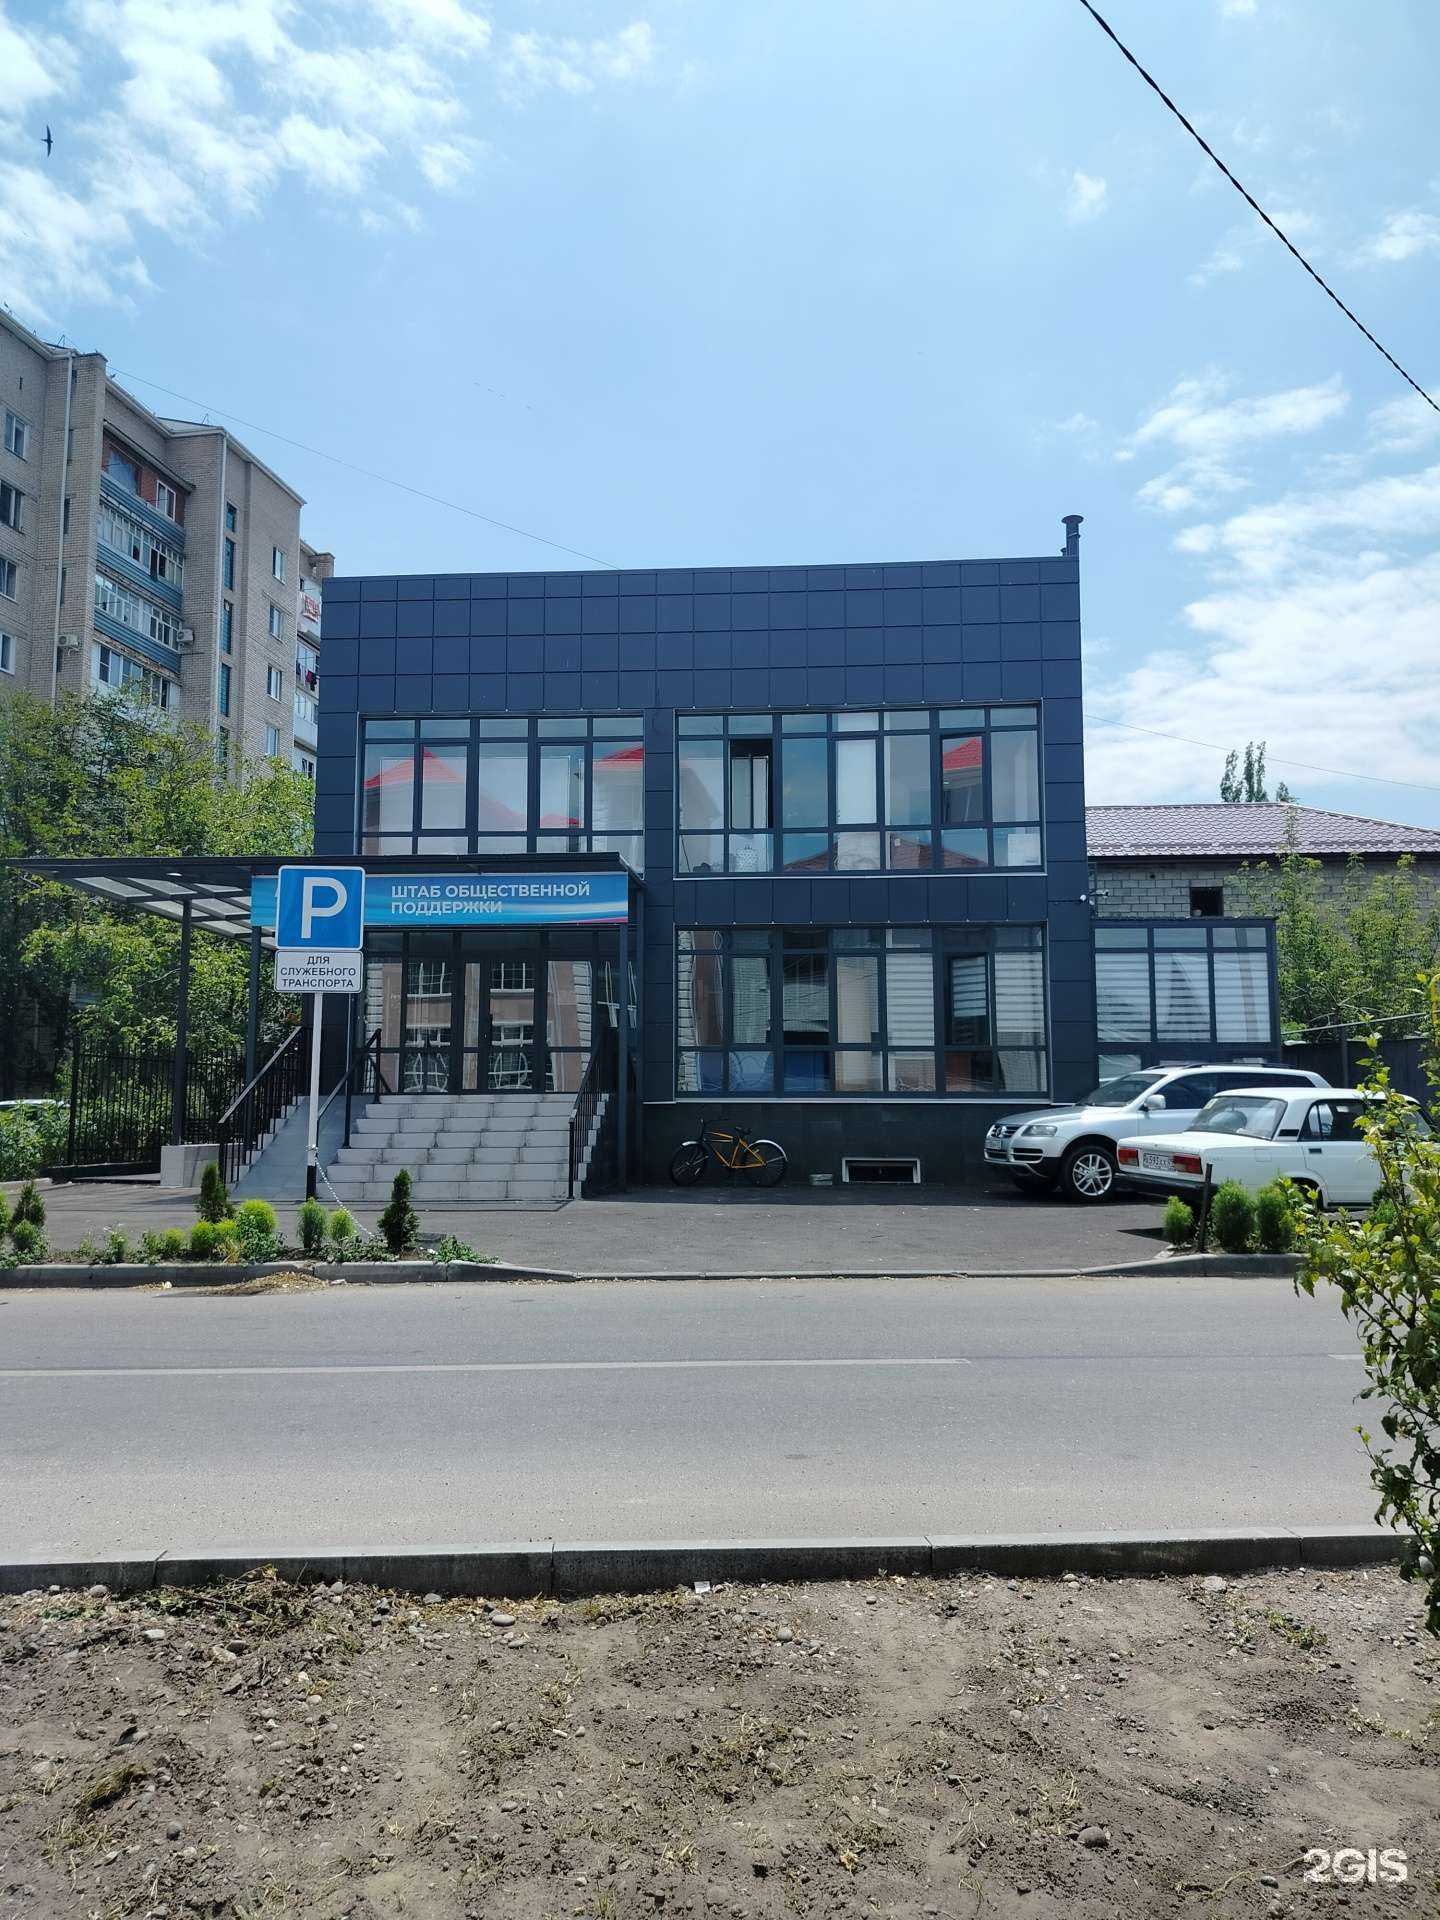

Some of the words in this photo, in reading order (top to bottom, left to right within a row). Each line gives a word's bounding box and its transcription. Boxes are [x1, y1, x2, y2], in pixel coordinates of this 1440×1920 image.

[391, 885, 441, 898] ШТАБ
[445, 881, 590, 899] ОБЩЕСТВЕННОЙ
[301, 876, 347, 939] P
[391, 901, 503, 916] ПОДДЕРЖКИ
[306, 956, 330, 966] ДЛЯ
[280, 967, 357, 976] СЛУЖЕБНОГО
[282, 978, 354, 988] ТРАНСПОРТА
